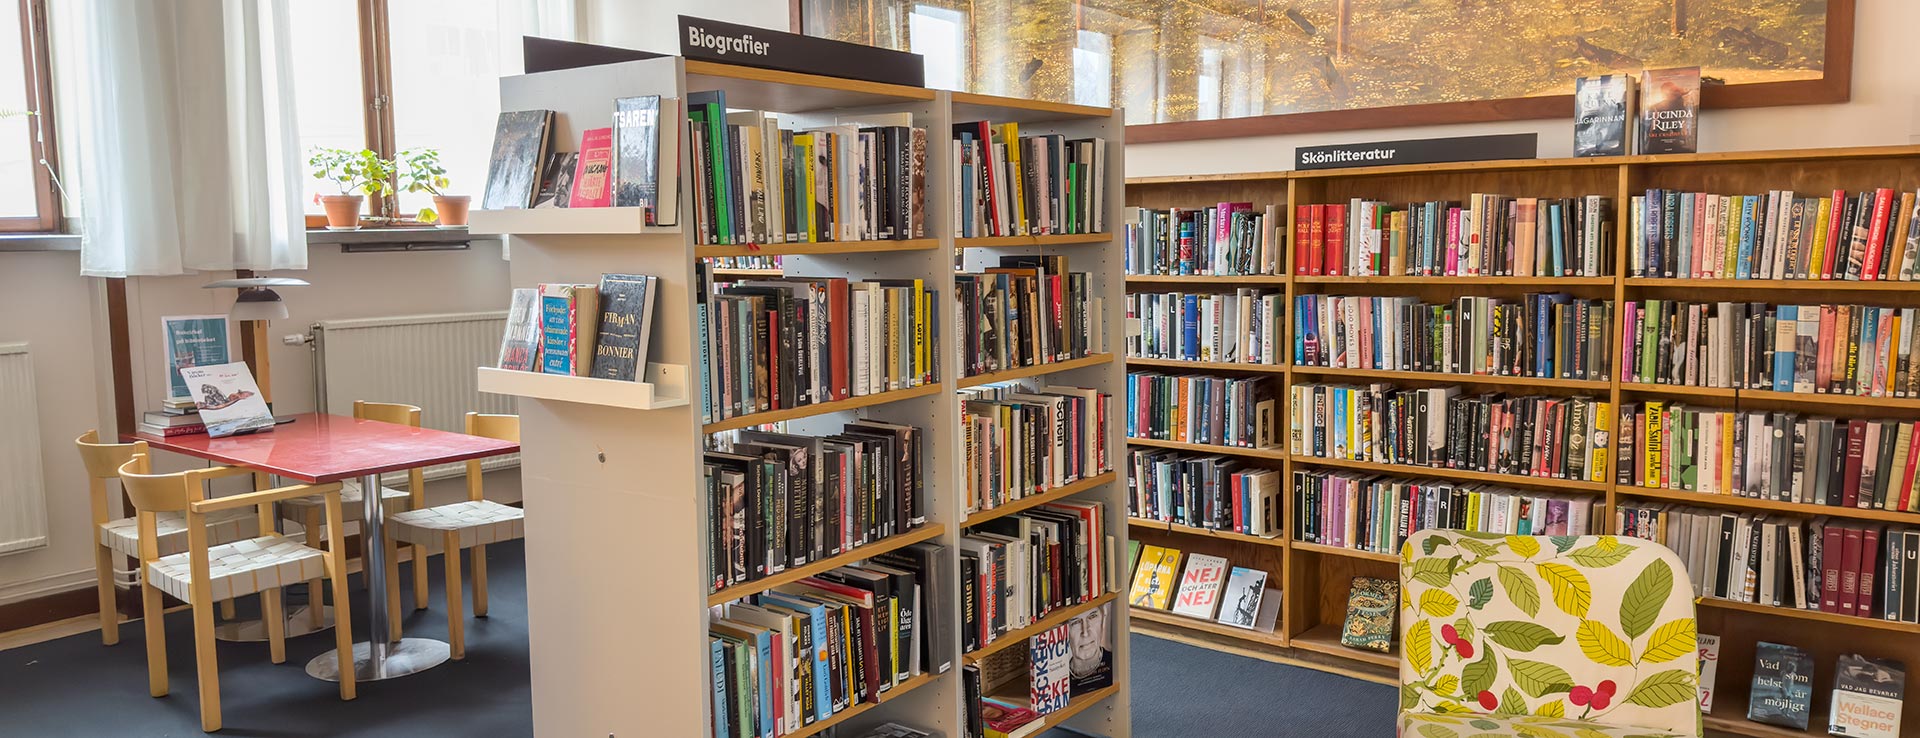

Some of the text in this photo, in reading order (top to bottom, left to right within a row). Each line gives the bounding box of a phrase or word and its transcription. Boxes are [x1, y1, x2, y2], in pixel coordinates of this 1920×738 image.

[688, 26, 770, 56] Biografier
[614, 108, 656, 128] TSAREN
[1645, 109, 1694, 122] LUCINDA
[1652, 119, 1686, 132] RILEY
[1301, 148, 1396, 164] Skönlitteratur
[1876, 197, 1886, 218] SALMAN
[1664, 194, 1675, 240] NORA ROBERTS
[604, 311, 636, 328] FIRMAN
[1463, 312, 1470, 320] N
[598, 344, 634, 360] BONNIER
[1316, 396, 1324, 425] INTRIGO
[1420, 404, 1426, 412] O
[1056, 401, 1064, 447] Schein
[1570, 400, 1586, 450] Amos Oz
[1649, 406, 1658, 429] ZADIE
[1648, 430, 1658, 452] SMITH
[794, 480, 802, 519] DIETRICH
[1440, 501, 1447, 510] R
[1399, 500, 1410, 537] EDGAR ALLAN POE
[1724, 532, 1731, 540] T
[1908, 550, 1916, 560] U
[1184, 567, 1222, 584] NEJ
[1198, 582, 1218, 590] ÅTER
[1178, 590, 1214, 608] NEJ
[715, 648, 725, 694] FALUDI
[1759, 658, 1780, 670] Vad
[1758, 676, 1782, 688] helst
[1785, 673, 1808, 683] som
[1794, 690, 1806, 698] är
[1869, 688, 1898, 698] BEVARAT
[1765, 697, 1804, 712] möjligt
[1839, 702, 1895, 720] Wallace
[1838, 714, 1894, 733] Stegner
